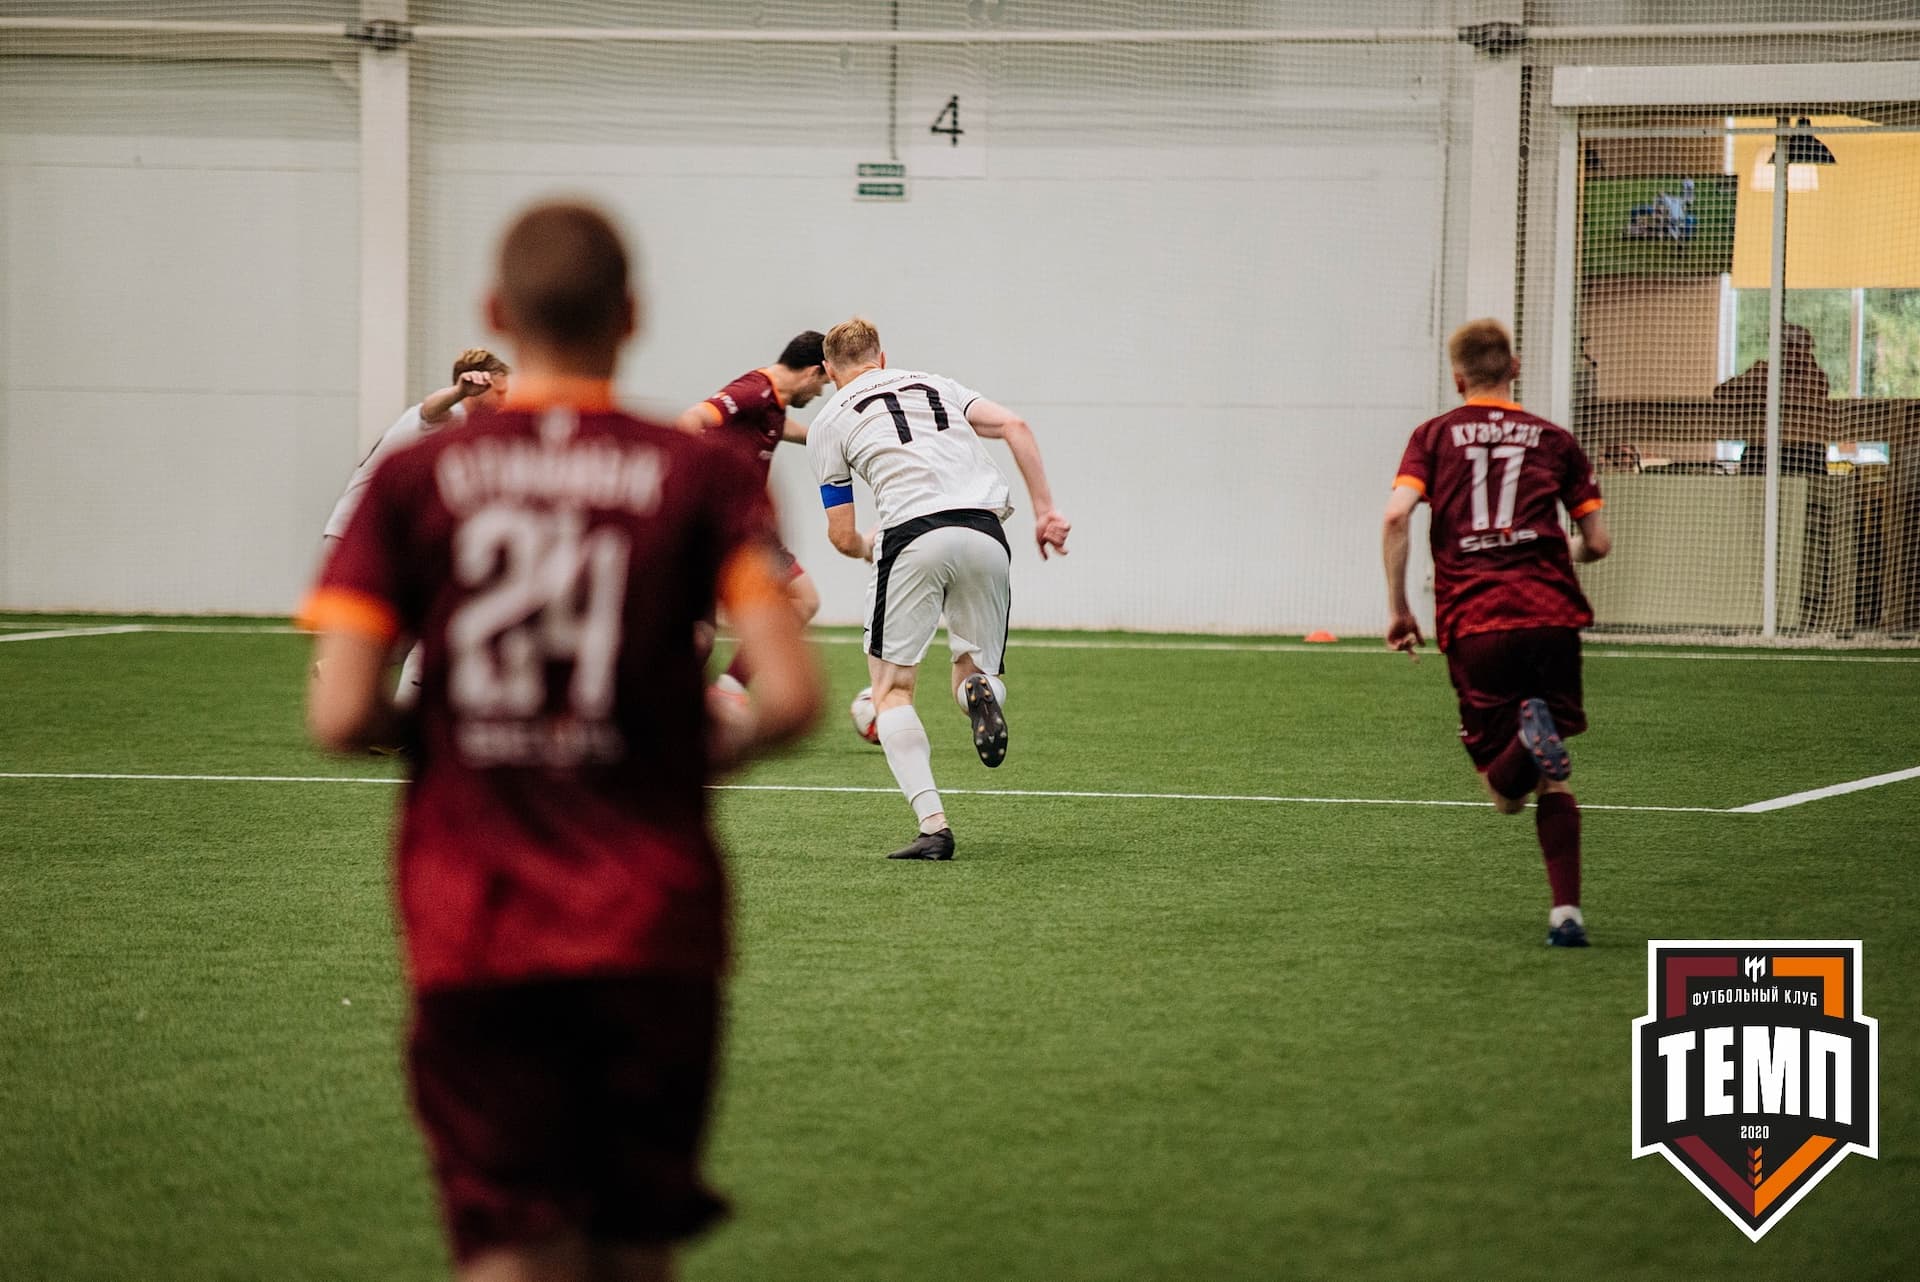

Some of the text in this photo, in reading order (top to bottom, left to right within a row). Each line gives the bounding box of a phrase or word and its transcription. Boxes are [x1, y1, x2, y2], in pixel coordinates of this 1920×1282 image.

[930, 94, 965, 147] 4
[852, 382, 950, 445] 77
[1465, 446, 1526, 532] 17
[1459, 528, 1538, 553] SEUS
[446, 498, 632, 719] 24
